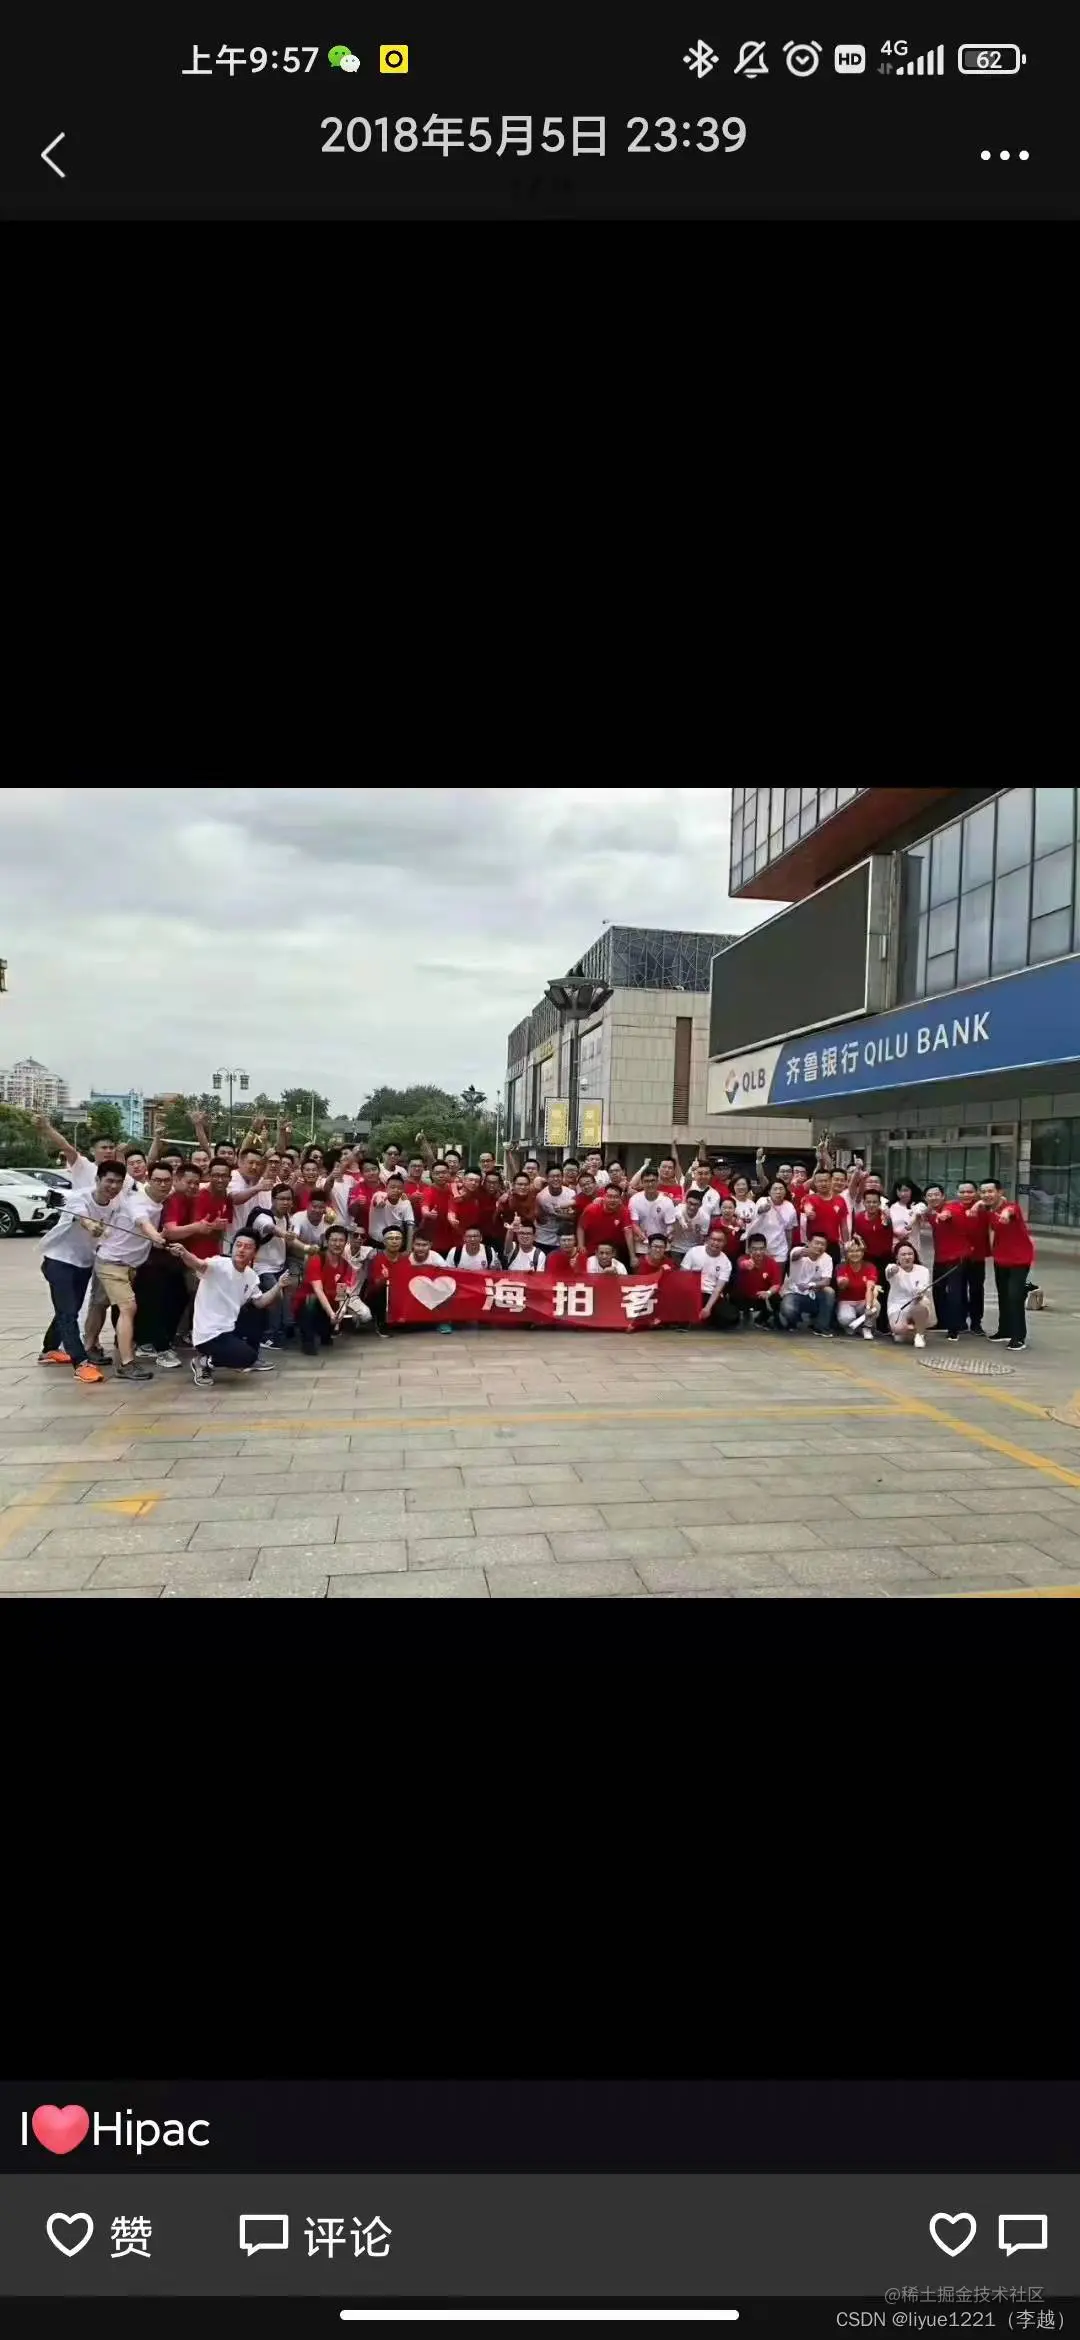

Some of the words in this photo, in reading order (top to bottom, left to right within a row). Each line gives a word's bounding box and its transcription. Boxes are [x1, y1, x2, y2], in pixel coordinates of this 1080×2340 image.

[182, 44, 319, 77] 上午9:57
[838, 52, 862, 66] HD
[880, 39, 908, 56] 4G
[976, 50, 1003, 69] 62
[320, 113, 606, 158] 2018年5月5日
[626, 116, 748, 153] 23:39
[786, 1041, 860, 1086] 齐鲁银行
[863, 1031, 909, 1066] QILU
[916, 1011, 992, 1055] BANK
[742, 1068, 766, 1093] QLB
[482, 1277, 660, 1320] 海拍客
[93, 2108, 211, 2156] Hipac
[110, 2215, 153, 2259] 赞
[304, 2215, 393, 2259] 评论
